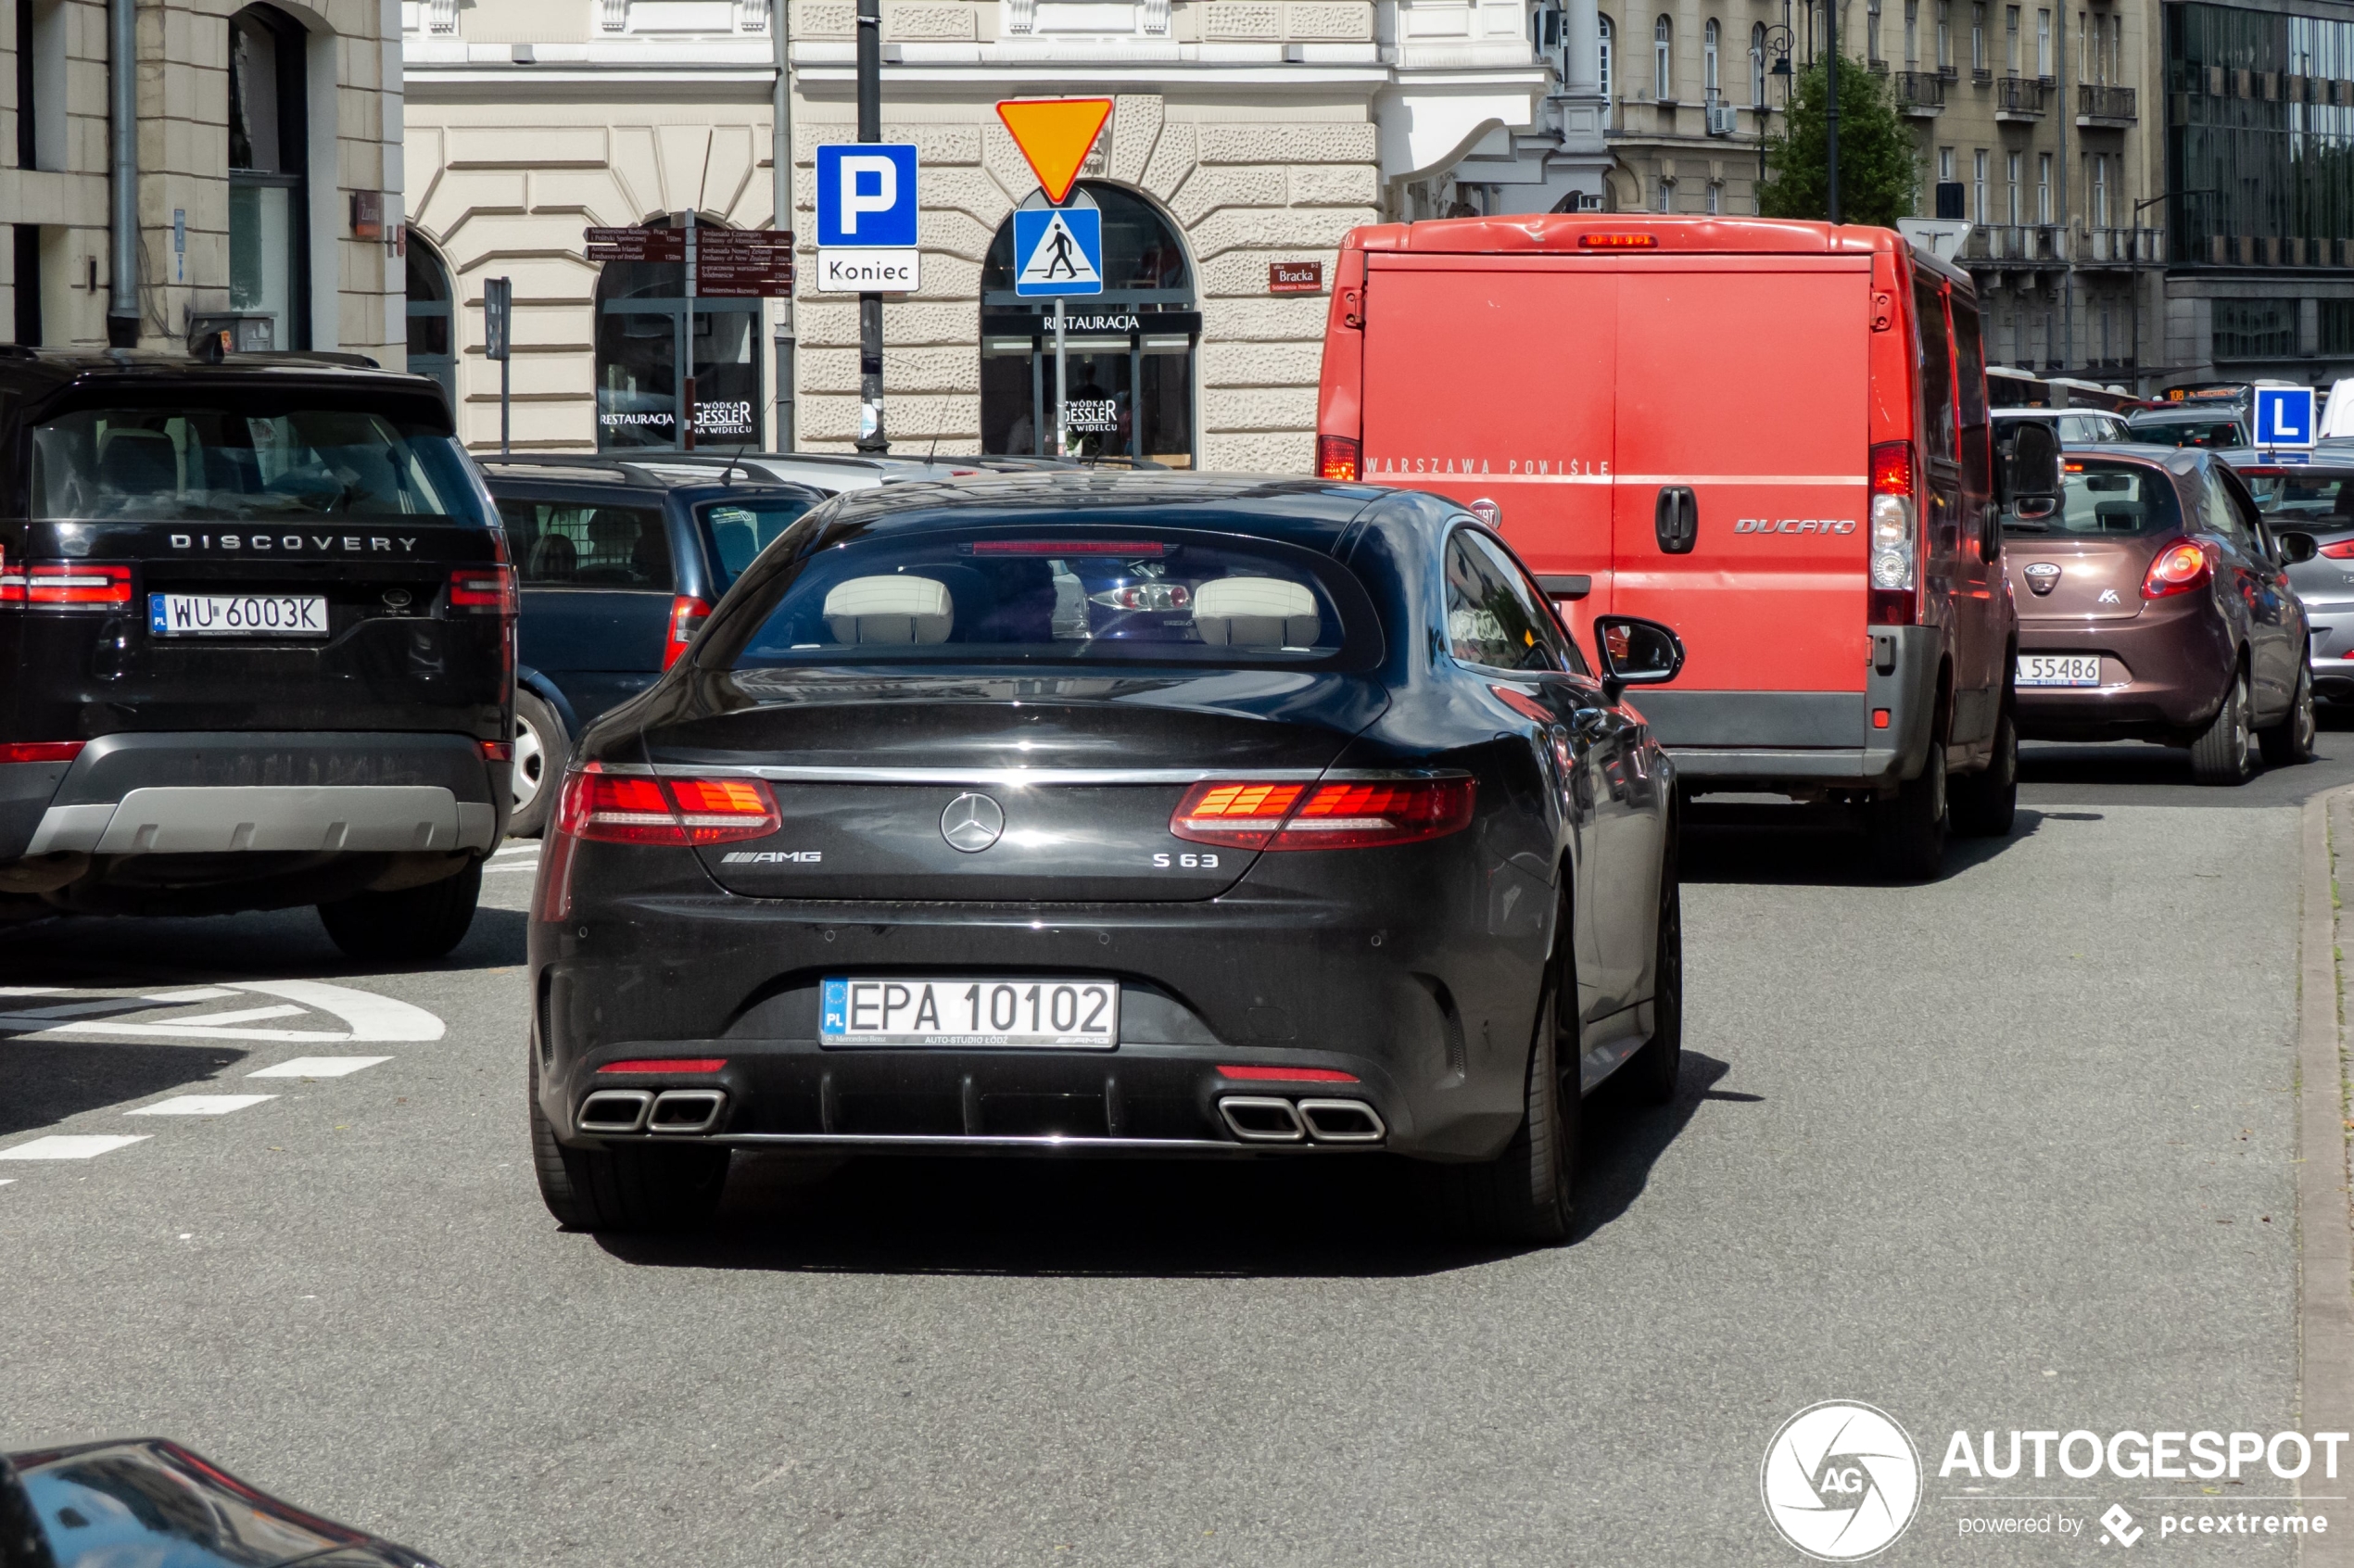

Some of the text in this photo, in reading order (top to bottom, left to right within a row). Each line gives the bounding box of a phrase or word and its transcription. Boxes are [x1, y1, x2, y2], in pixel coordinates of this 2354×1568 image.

[841, 156, 897, 234] P
[829, 261, 908, 280] Koniec
[1279, 269, 1314, 282] Bracka
[2170, 389, 2184, 401] 108
[703, 401, 739, 410] WÓDKA
[1069, 399, 1105, 408] WÓDKA
[600, 413, 675, 426] RESTAURACJA
[2274, 398, 2299, 436] L
[710, 425, 753, 434] WIDELCU
[1076, 424, 1118, 433] WIDELCU
[1365, 458, 1609, 476] WARSZAWA POWIŚLE
[1734, 519, 1856, 535] DUCATO
[171, 535, 417, 551] DISCOVERY
[173, 598, 318, 628] WU 6003K
[155, 617, 167, 626] PL
[2031, 658, 2096, 678] 55486
[1153, 854, 1219, 868] S 63
[850, 983, 1109, 1033] EPA 10102
[827, 1013, 843, 1027] PL
[835, 1035, 887, 1043] Mercedes-Benz
[925, 1036, 983, 1044] AUTO-STUDIO
[985, 1034, 1008, 1044] ŁÓDŹ
